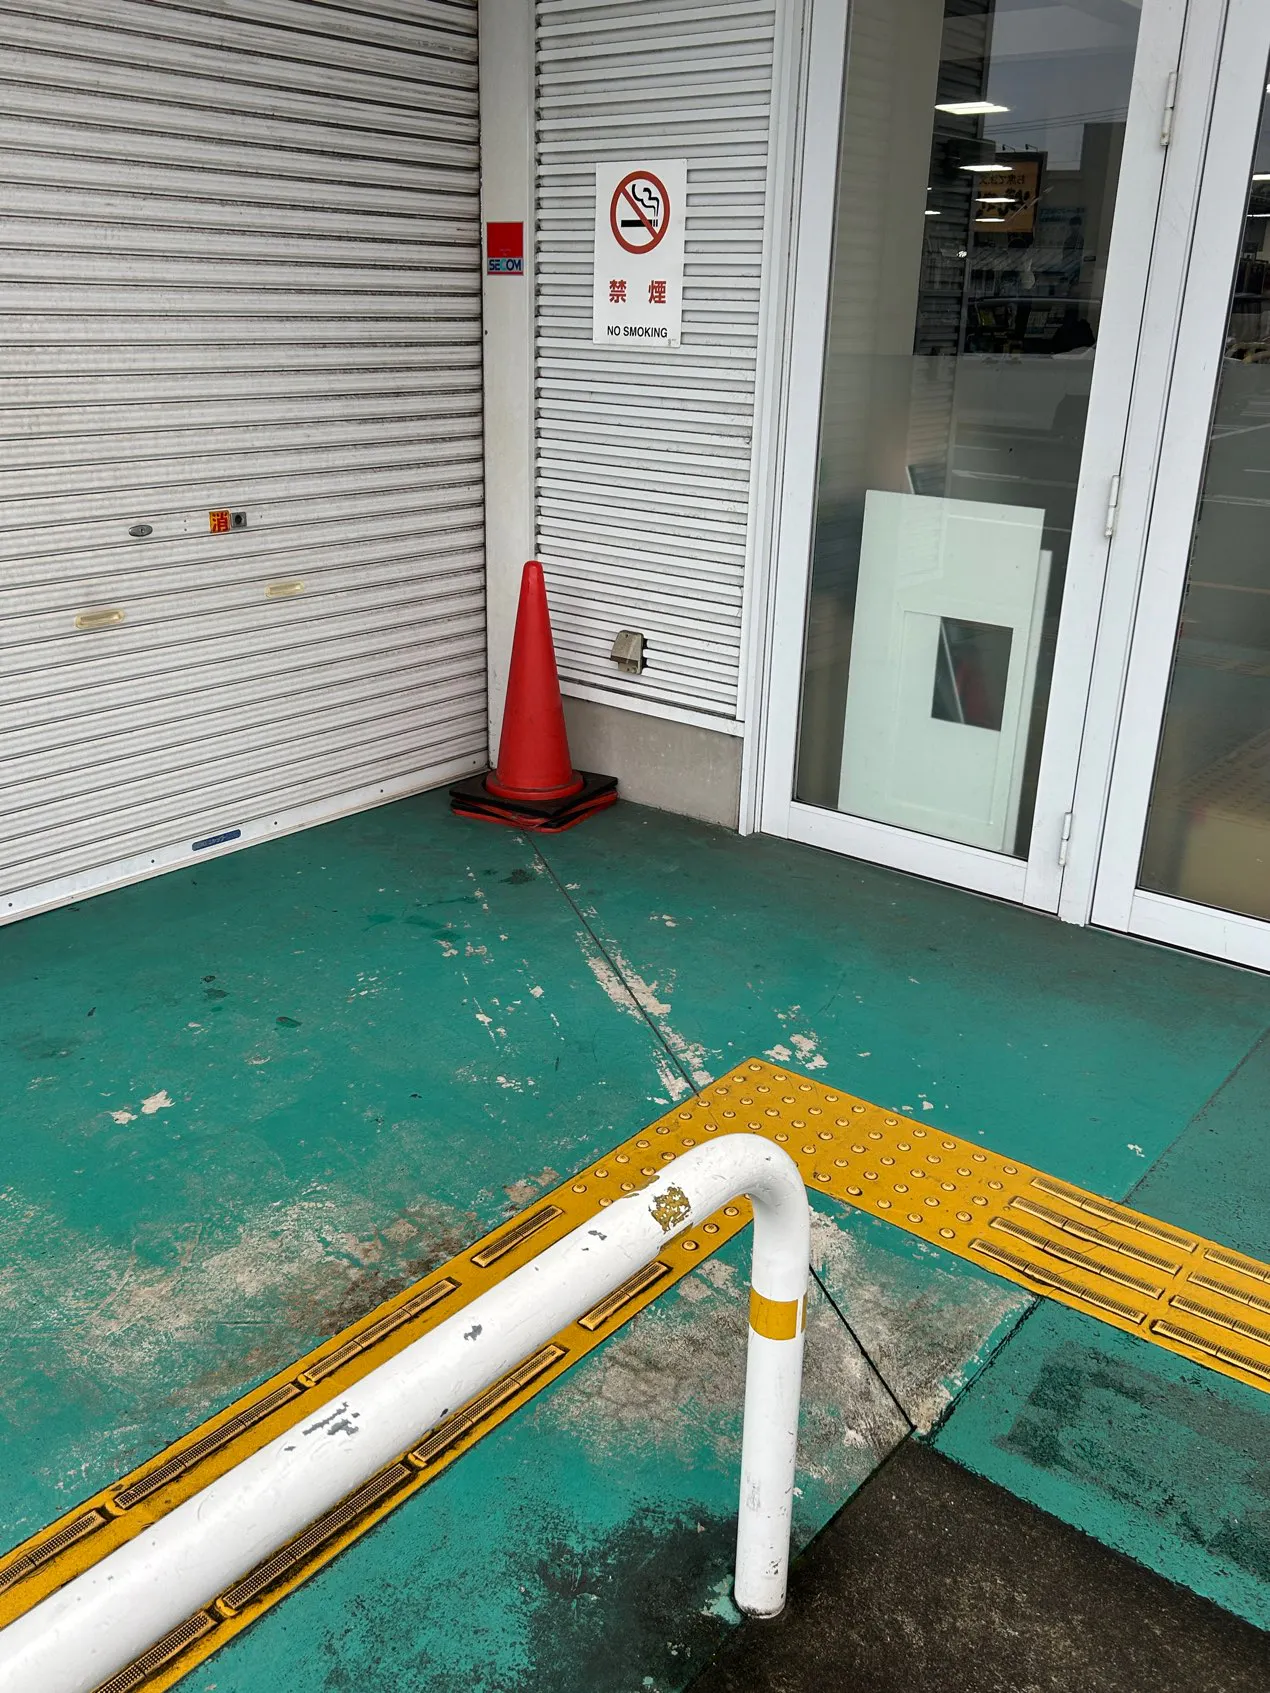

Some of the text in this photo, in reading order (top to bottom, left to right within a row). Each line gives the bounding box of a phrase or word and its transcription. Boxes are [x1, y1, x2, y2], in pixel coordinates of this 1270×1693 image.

[488, 258, 522, 272] SECOM
[607, 325, 668, 338] NO SMOKING
